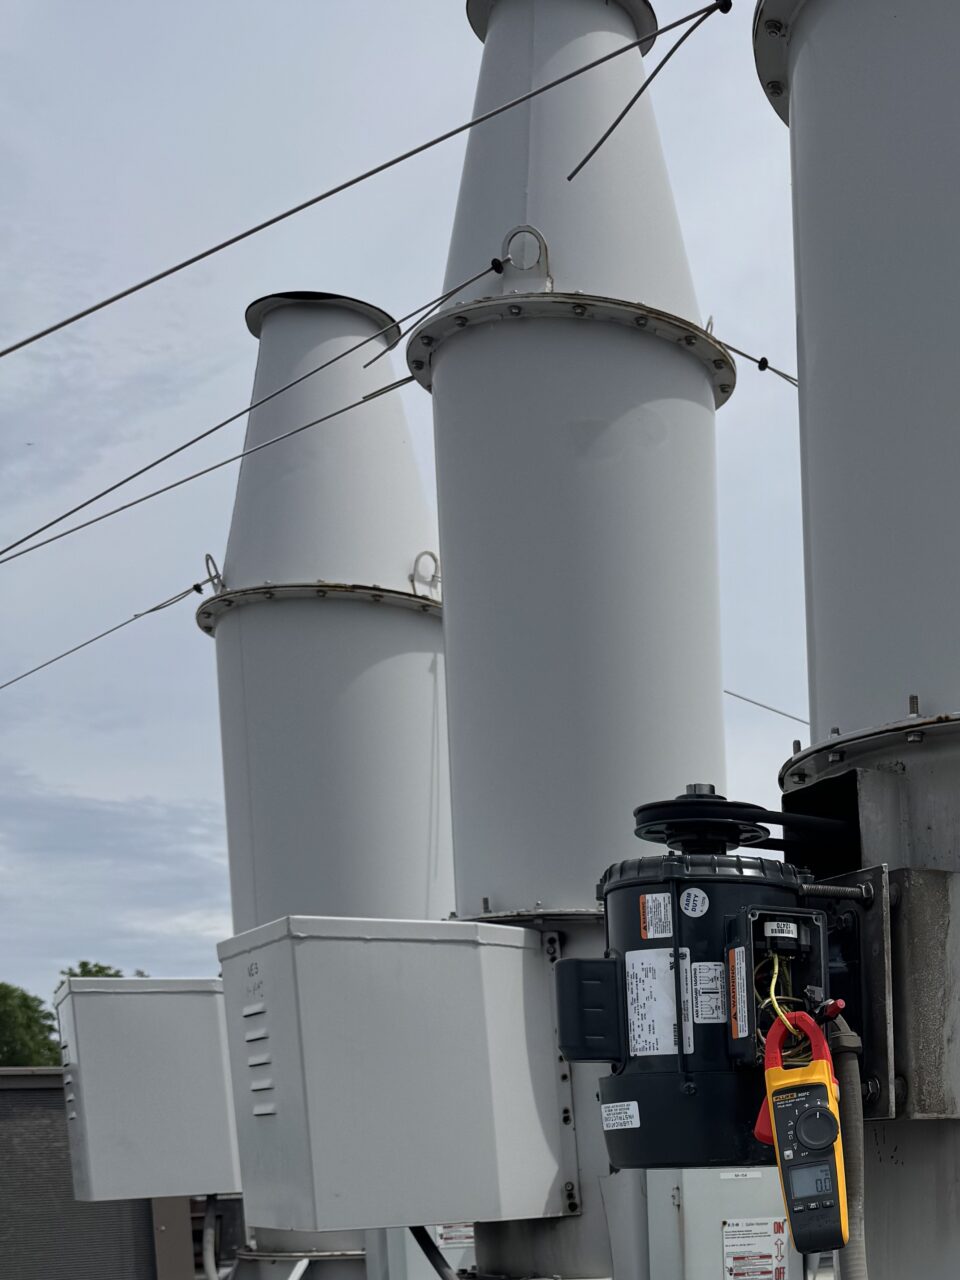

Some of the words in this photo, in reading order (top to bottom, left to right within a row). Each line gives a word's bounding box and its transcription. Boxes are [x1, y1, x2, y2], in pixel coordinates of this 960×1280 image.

[684, 893, 692, 911] FARM
[773, 1221, 784, 1234] ON
[774, 1266, 785, 1280] OFF
